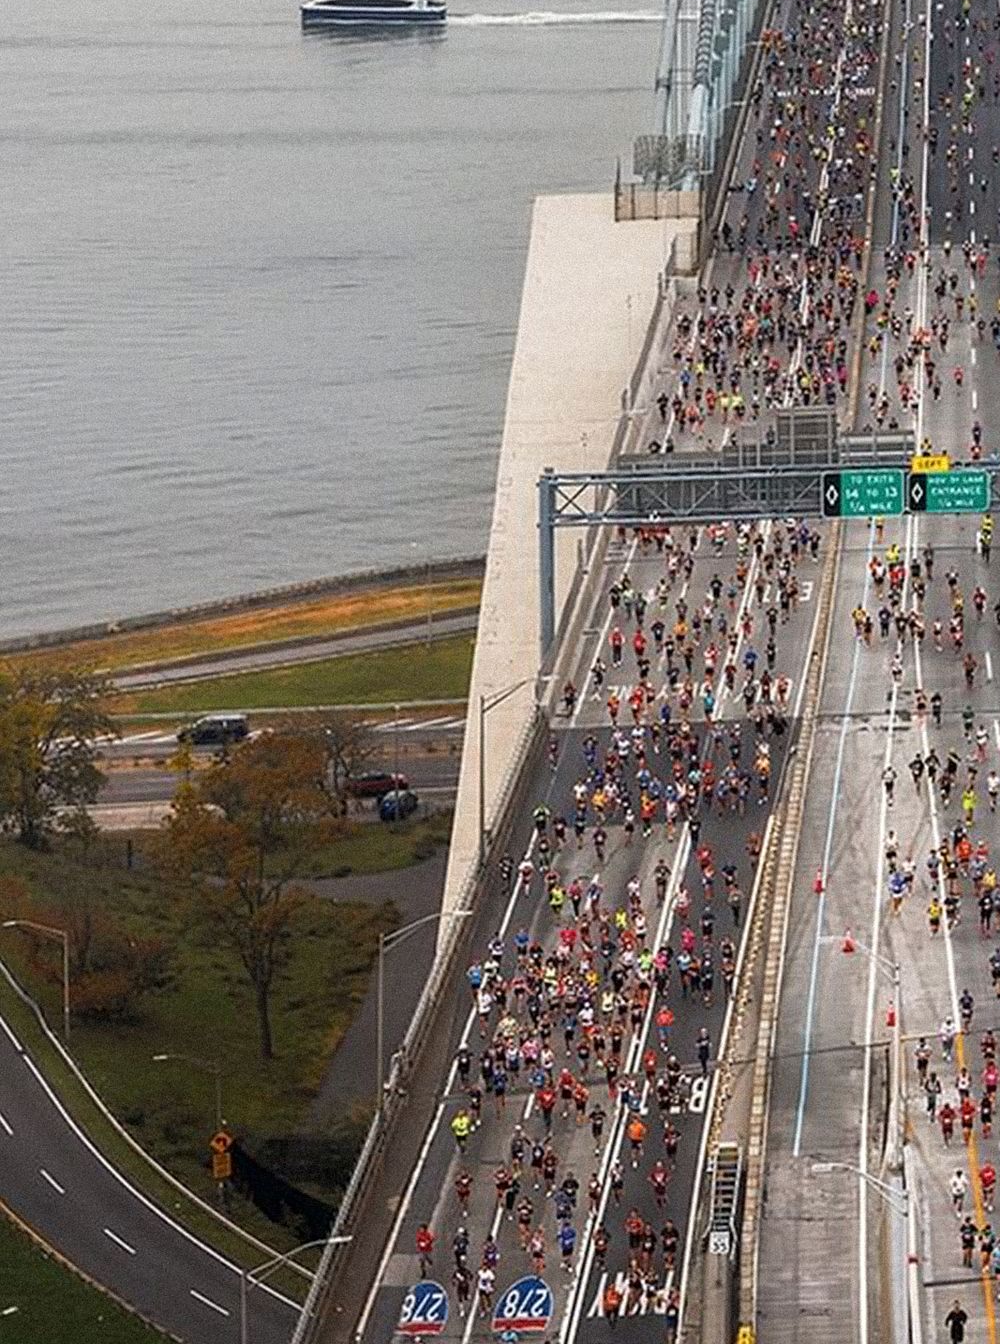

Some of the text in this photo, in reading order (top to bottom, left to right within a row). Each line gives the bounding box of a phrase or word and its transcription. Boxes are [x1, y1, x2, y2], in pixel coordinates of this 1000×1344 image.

[851, 475, 863, 484] TO
[845, 486, 898, 499] 14 TO 13
[931, 487, 981, 496] ENTRANCE
[762, 580, 814, 602] EIT
[401, 1293, 444, 1321] 278
[503, 1288, 547, 1317] 278
